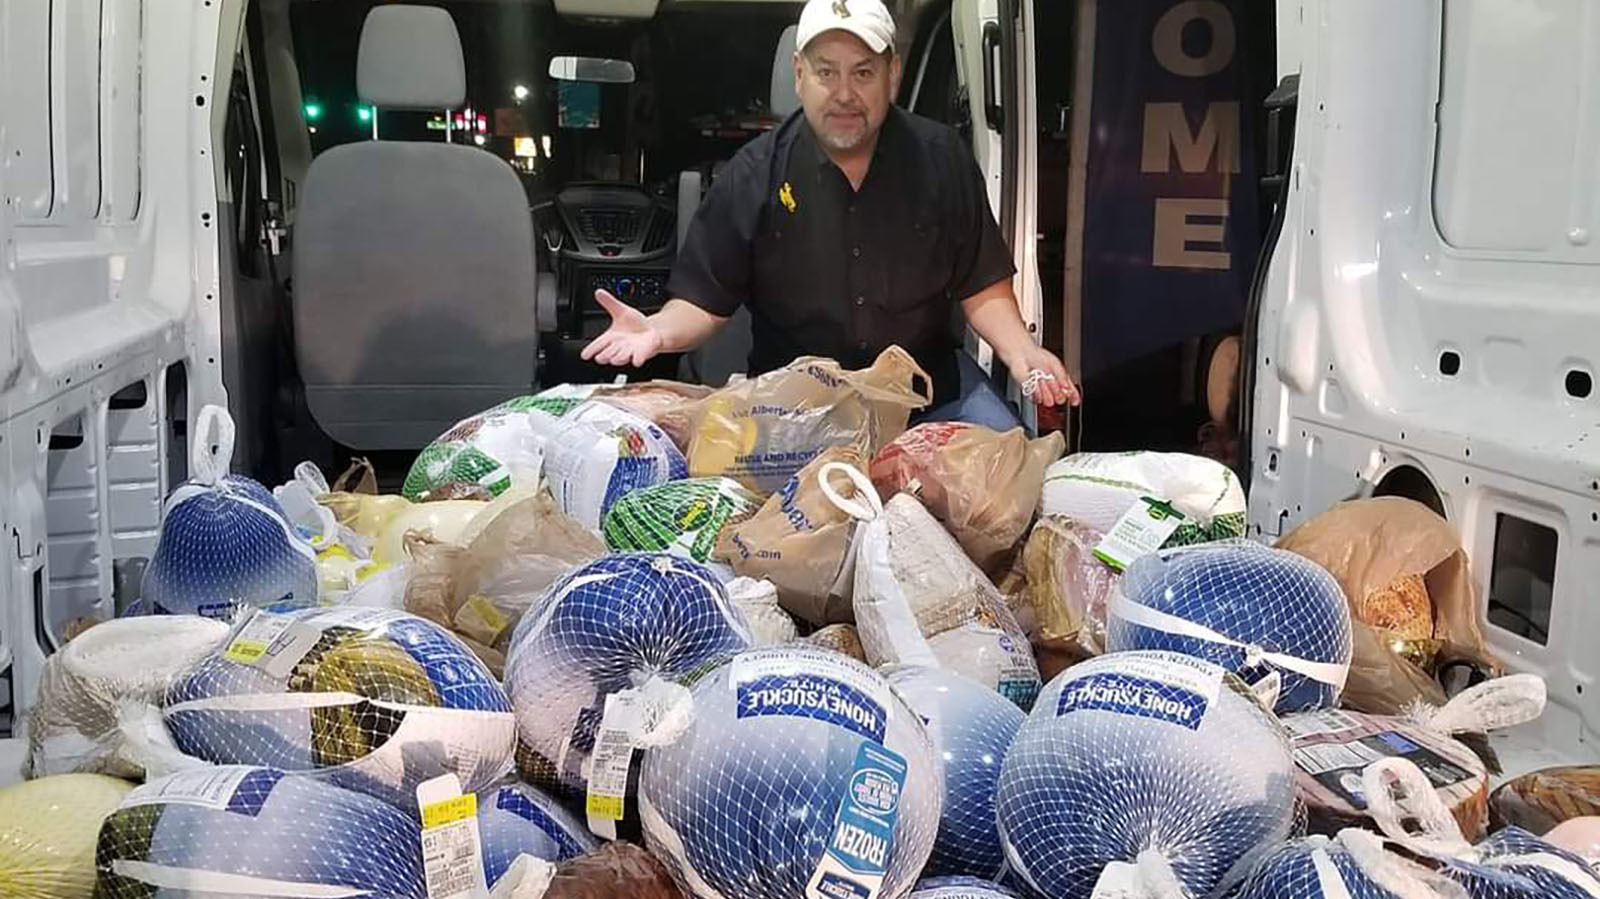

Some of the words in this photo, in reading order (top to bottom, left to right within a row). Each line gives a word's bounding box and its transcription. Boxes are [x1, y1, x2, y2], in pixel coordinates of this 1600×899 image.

[763, 453, 784, 463] AND
[748, 687, 876, 731] HONEYSUCKLE
[1067, 685, 1193, 720] HONEYSUCKLE
[833, 821, 888, 866] FROZEN
